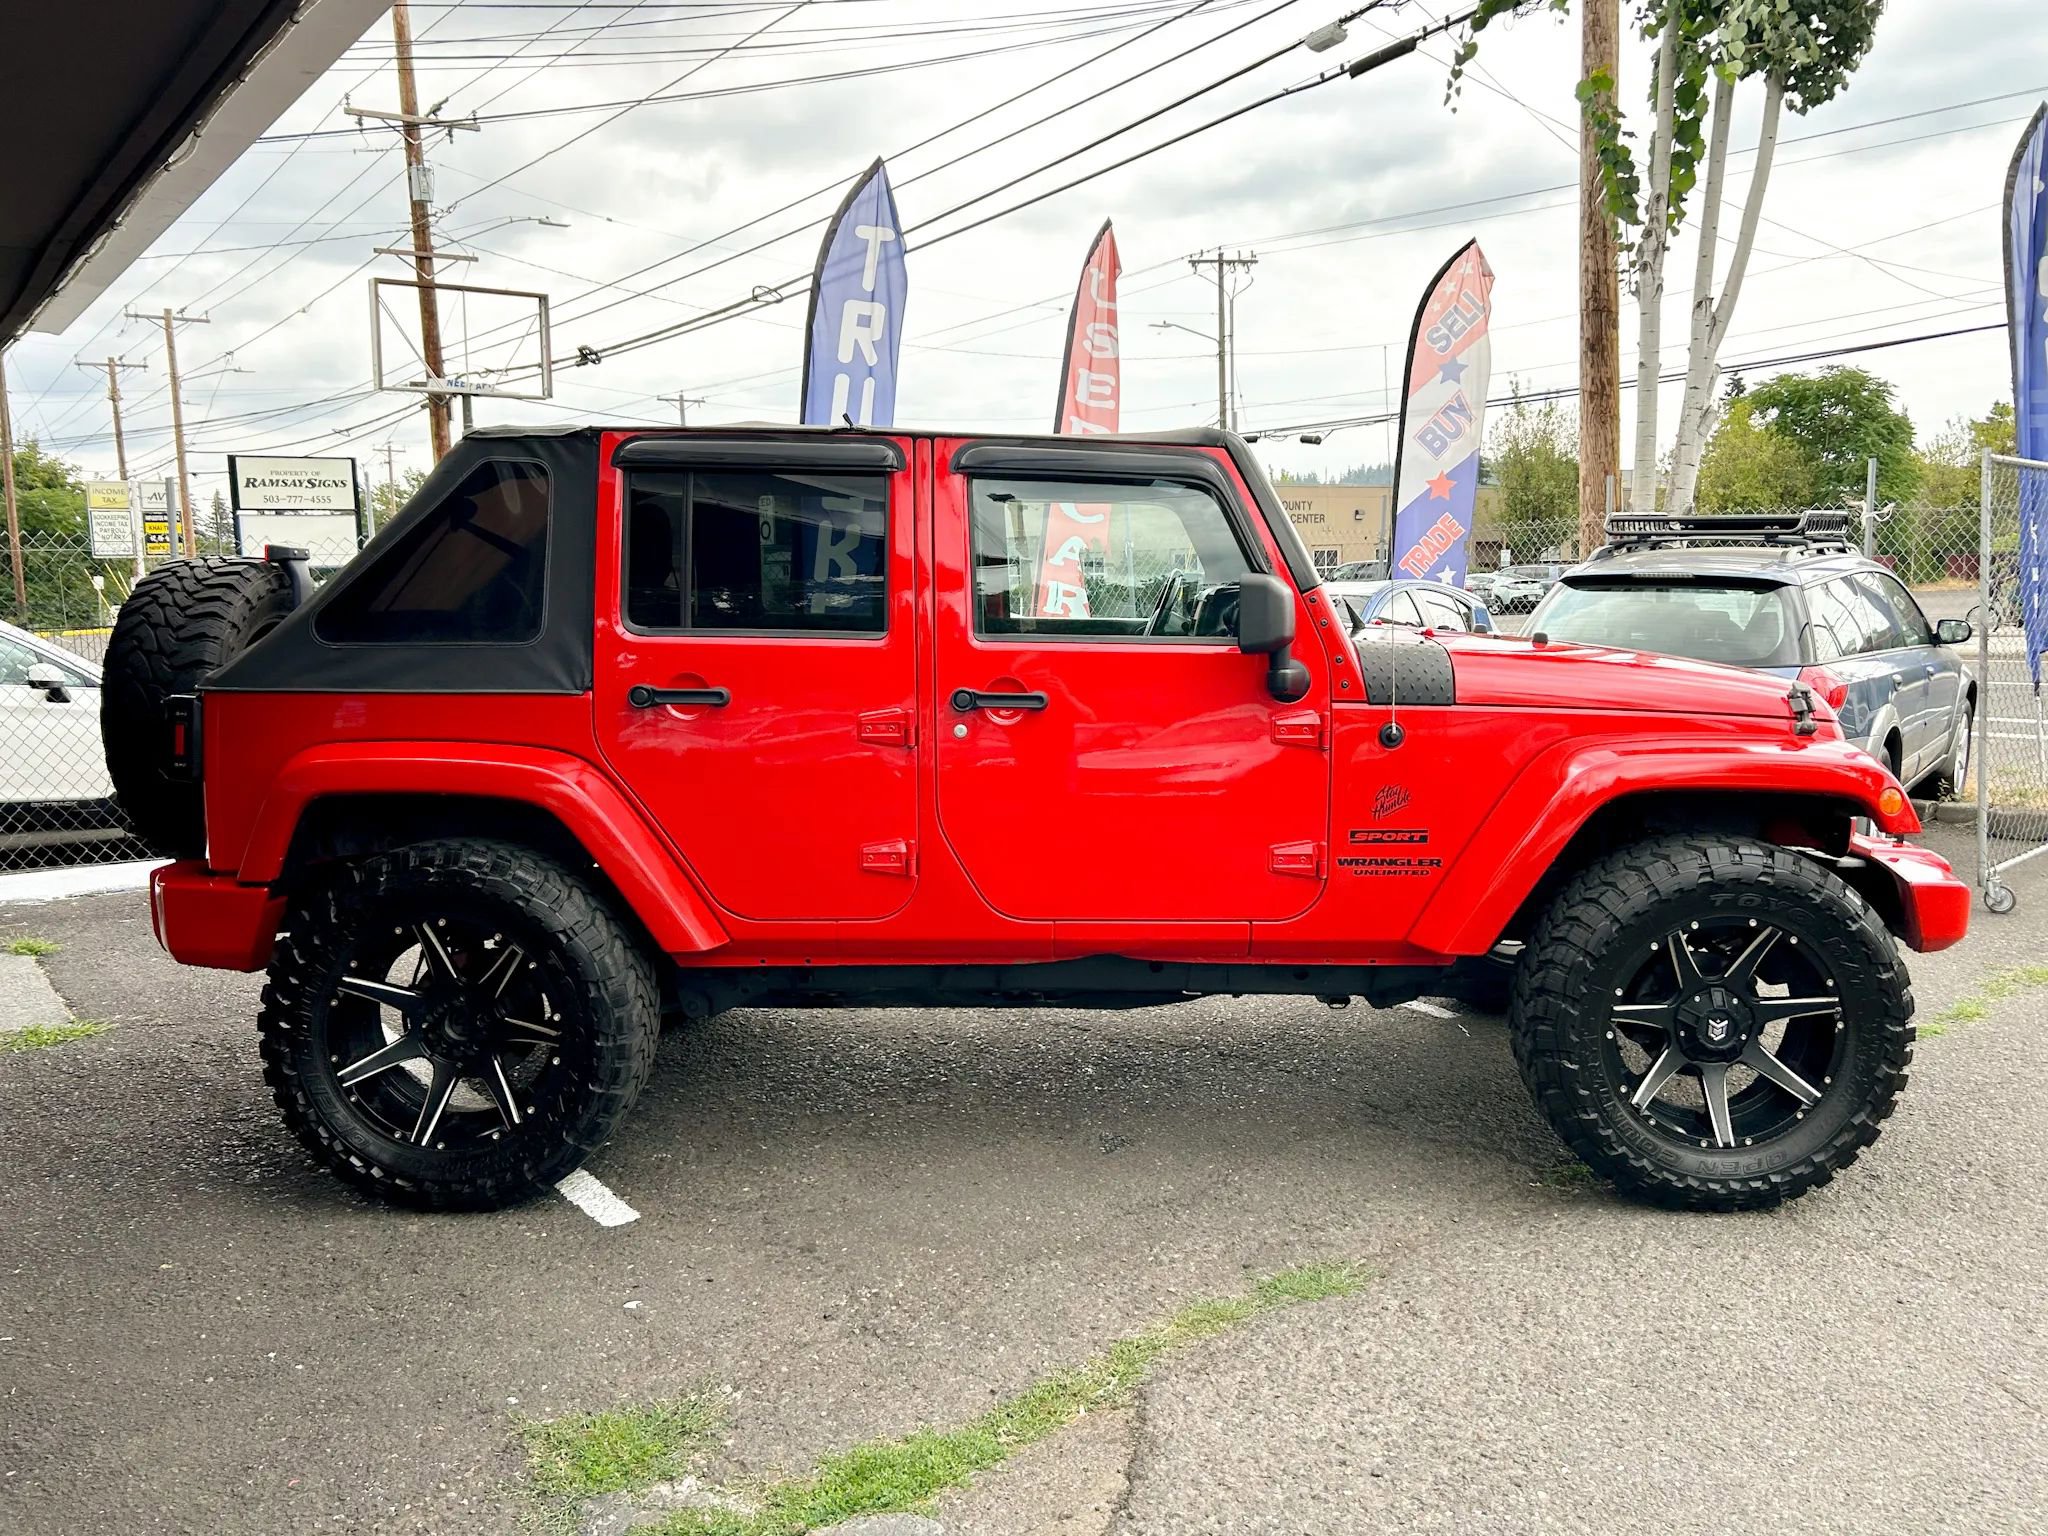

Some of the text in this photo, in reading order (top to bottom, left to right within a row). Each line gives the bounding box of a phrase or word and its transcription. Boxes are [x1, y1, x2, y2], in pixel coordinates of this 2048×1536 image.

[1425, 290, 1487, 356] SELL
[1414, 391, 1477, 460] BUY
[102, 496, 117, 504] TAX
[263, 495, 332, 504] 503-777-4555
[1282, 500, 1313, 511] OUNTY
[1290, 513, 1326, 524] CENTER
[1398, 512, 1466, 579] TRADE
[1354, 832, 1428, 841] SPORT
[1337, 858, 1442, 867] WRANGLER
